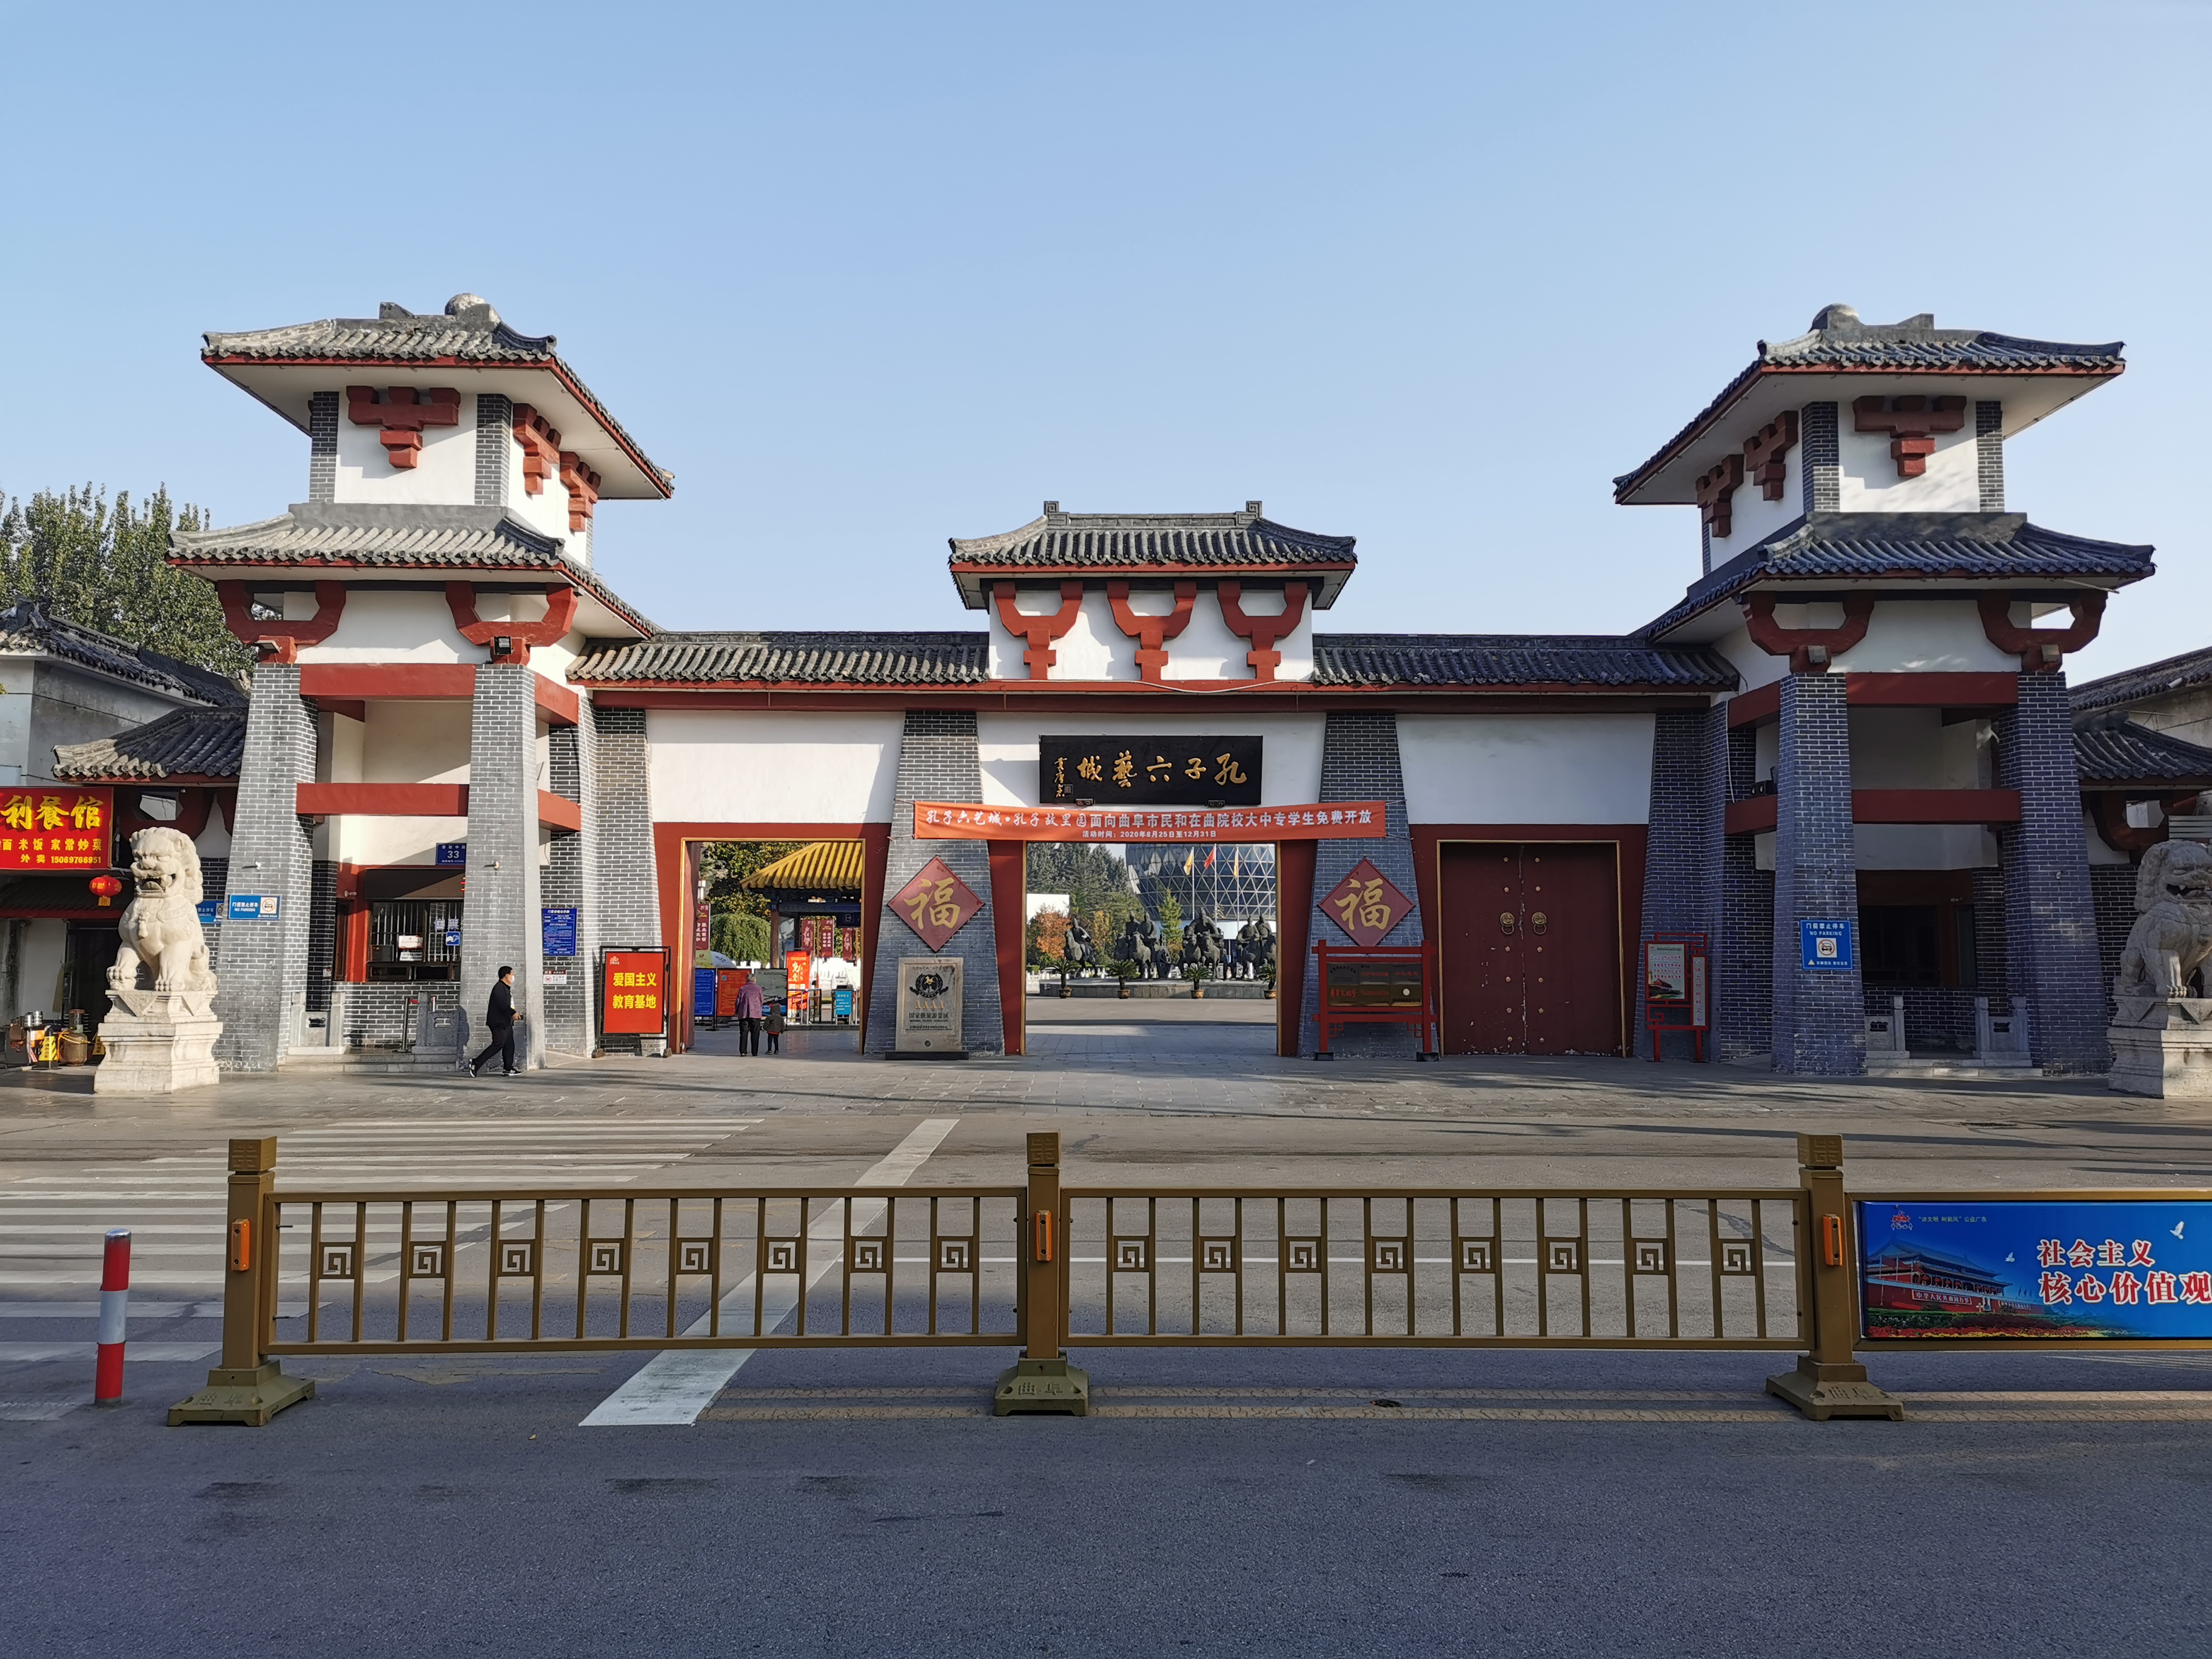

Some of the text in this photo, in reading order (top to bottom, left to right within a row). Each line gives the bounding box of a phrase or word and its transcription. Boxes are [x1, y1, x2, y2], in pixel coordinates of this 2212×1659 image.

[1, 794, 104, 830] 利餐馆
[0, 838, 102, 851] 面 米饭 家常炒菜
[21, 854, 45, 863] 外卖
[447, 850, 460, 859] 33
[903, 877, 960, 930] 福
[1334, 877, 1391, 931] 福
[434, 918, 464, 930] 售票
[612, 972, 657, 987] 爱国主义
[612, 994, 657, 1009] 教育基地
[2037, 1239, 2156, 1268] 社会主义
[2038, 1270, 2212, 1305] 核心价值观
